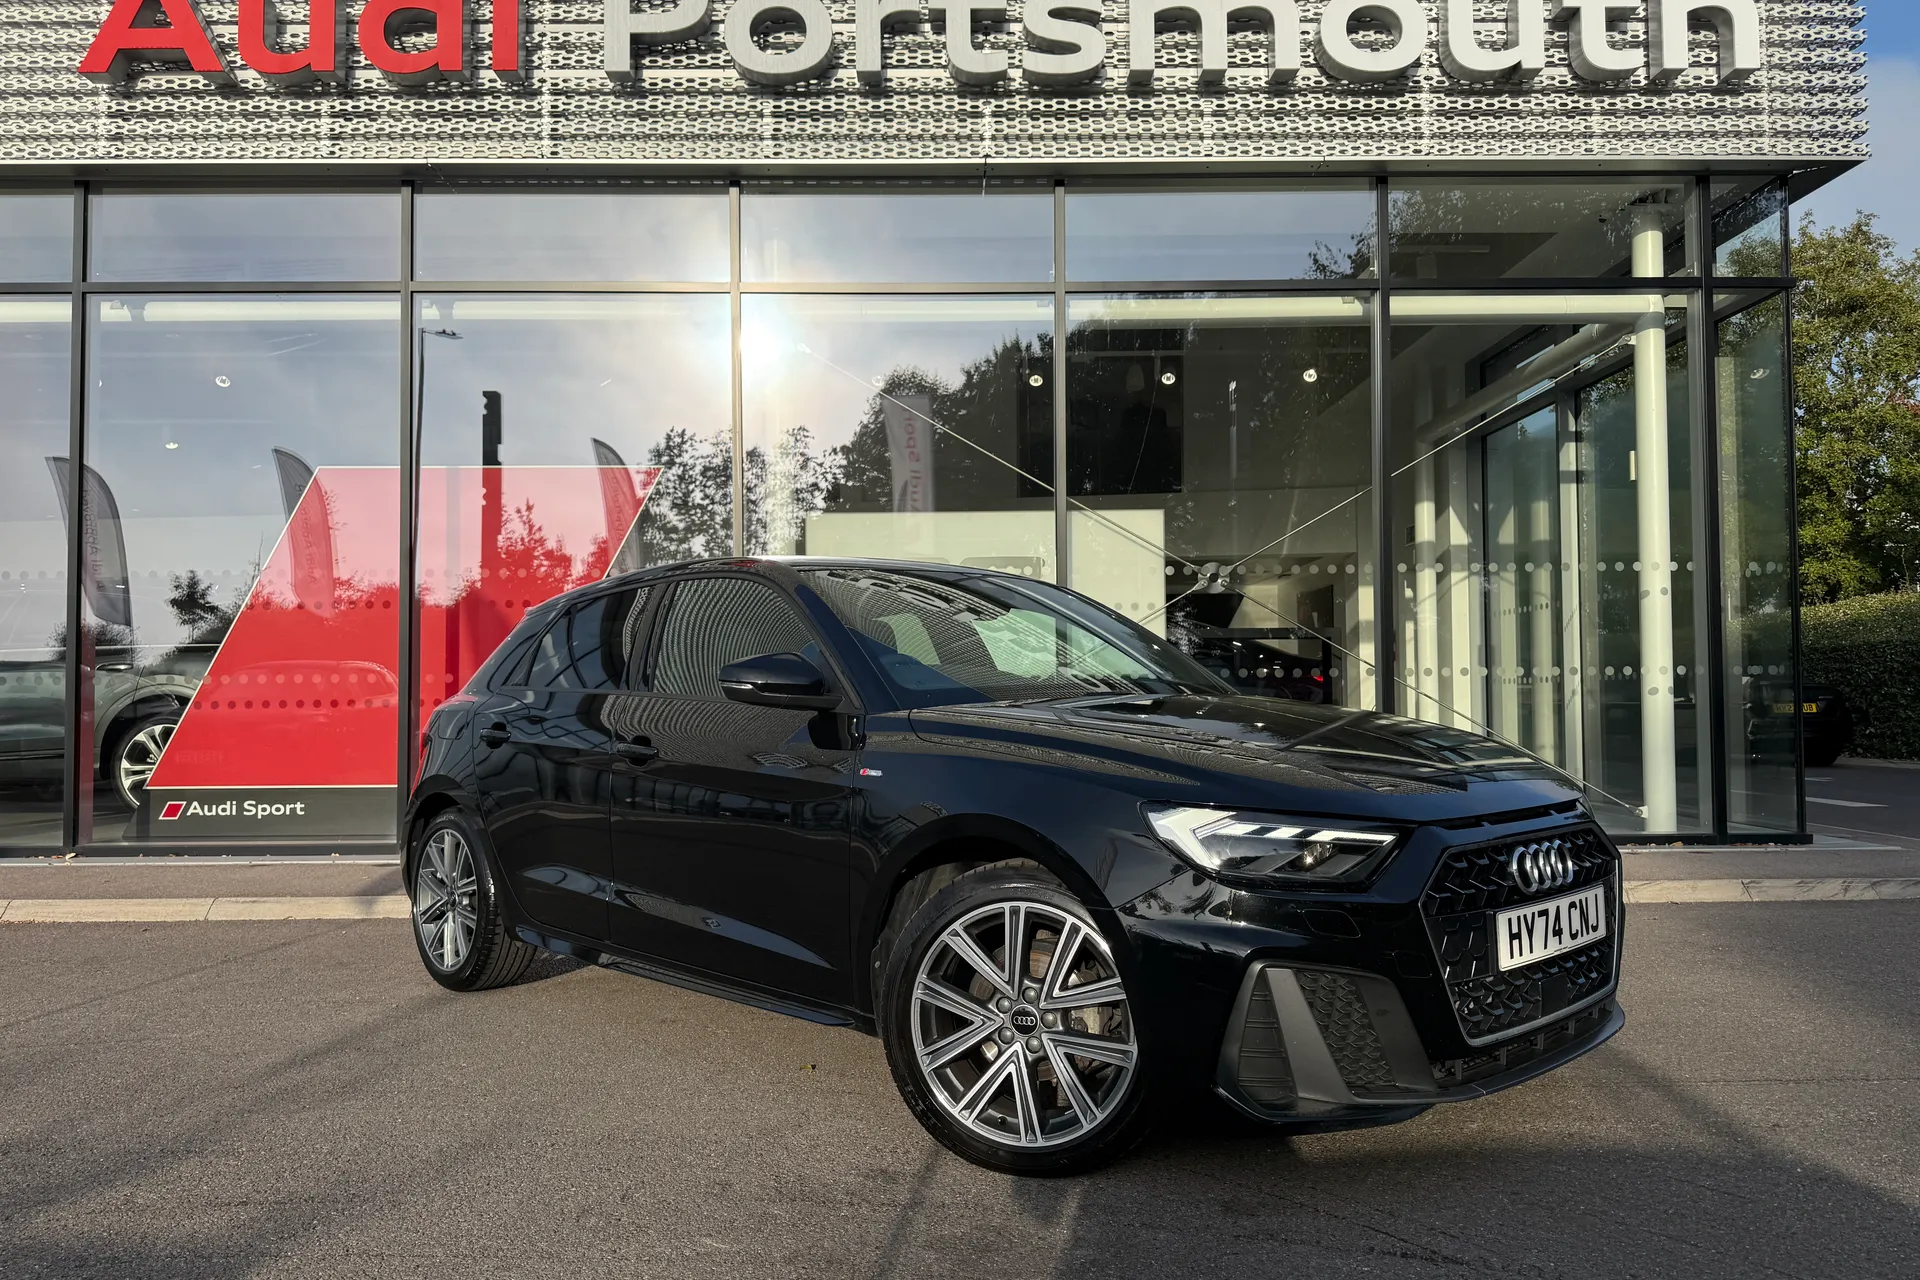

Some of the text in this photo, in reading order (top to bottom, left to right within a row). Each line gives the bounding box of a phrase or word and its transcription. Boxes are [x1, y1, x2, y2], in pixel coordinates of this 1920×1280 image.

[78, 0, 1760, 79] Audi Portsmouth
[186, 801, 305, 819] Audi Sport
[1508, 893, 1599, 960] HY74 CNJ
